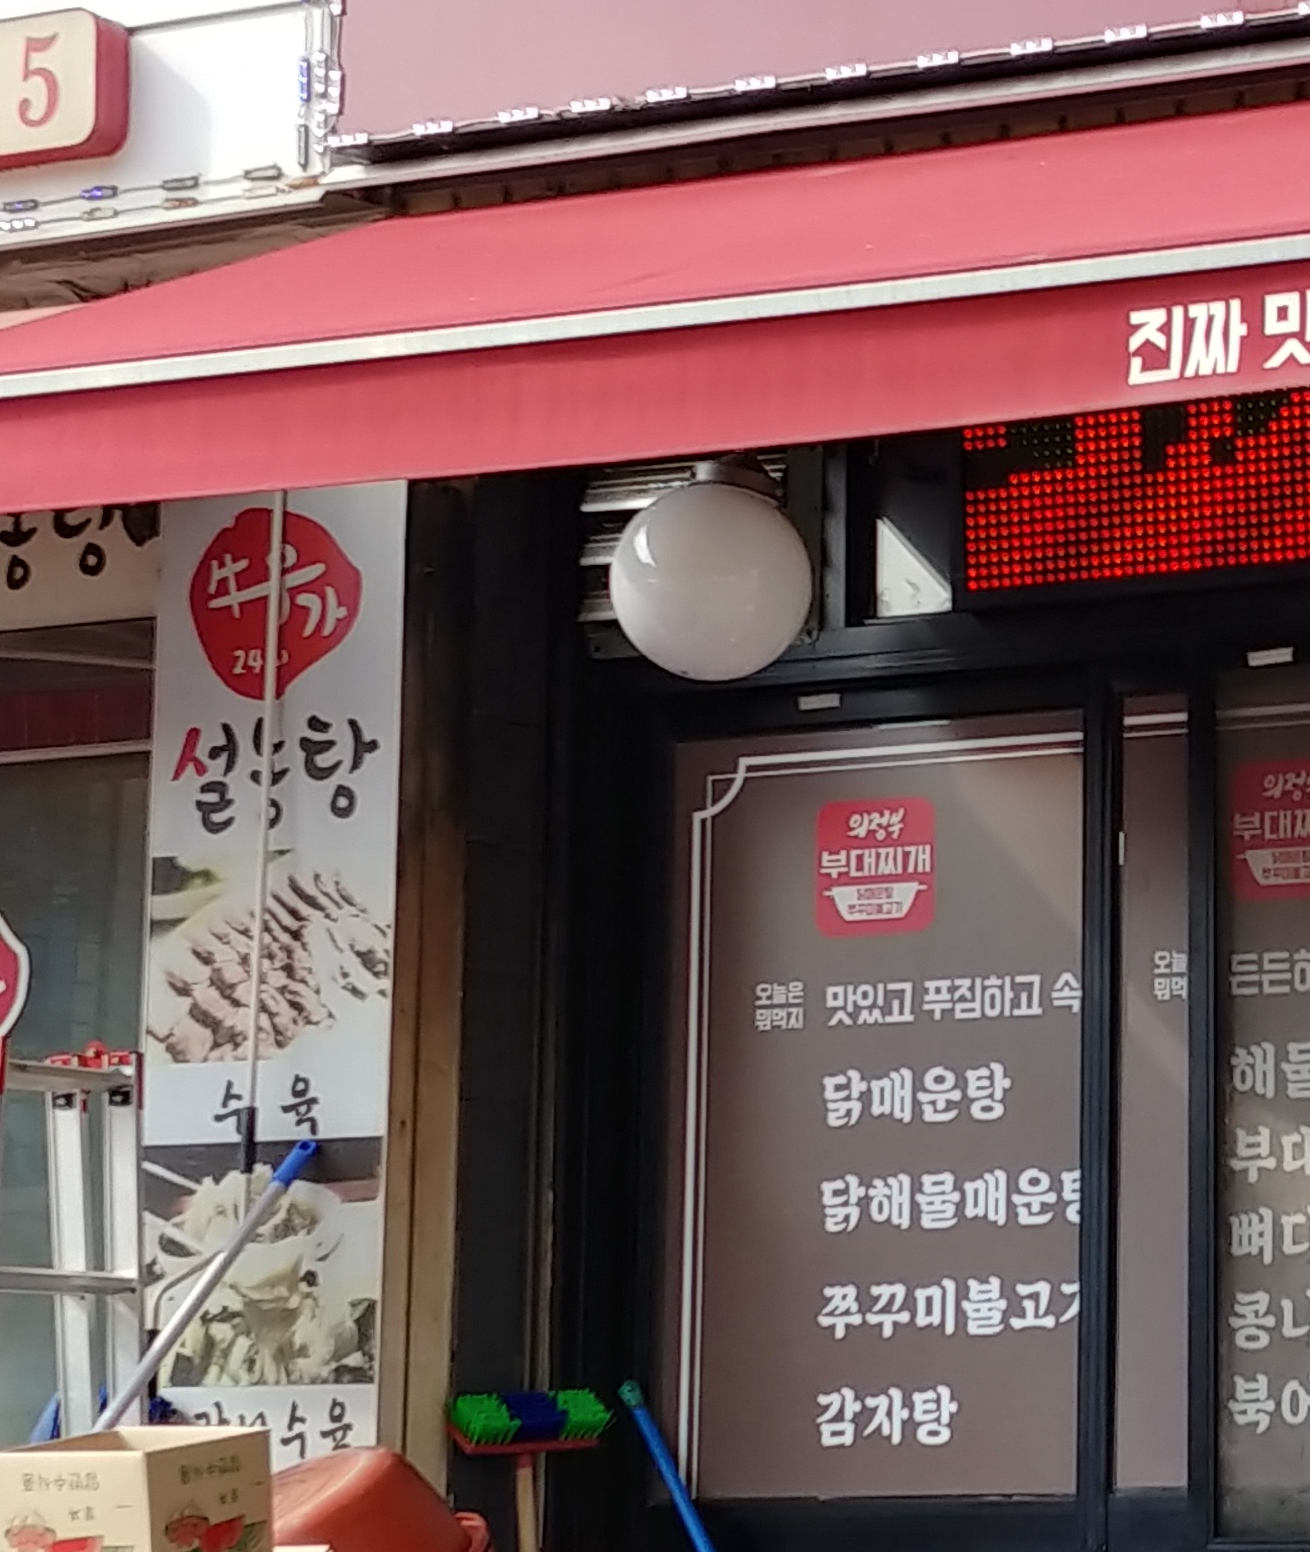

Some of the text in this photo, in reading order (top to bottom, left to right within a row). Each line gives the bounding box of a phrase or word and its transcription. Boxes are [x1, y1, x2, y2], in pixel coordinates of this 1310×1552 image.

[1126, 296, 1246, 387] 진짜
[846, 807, 904, 841] 의정부
[819, 844, 932, 879] 부대찌개
[1153, 950, 1188, 975] 오늘
[754, 971, 1082, 1027] 오늘은 맛있고 푸짐하고 속
[213, 1074, 320, 1137] 수육
[821, 1062, 1012, 1128] 닭매운탕
[815, 1384, 958, 1448] 감자탕
